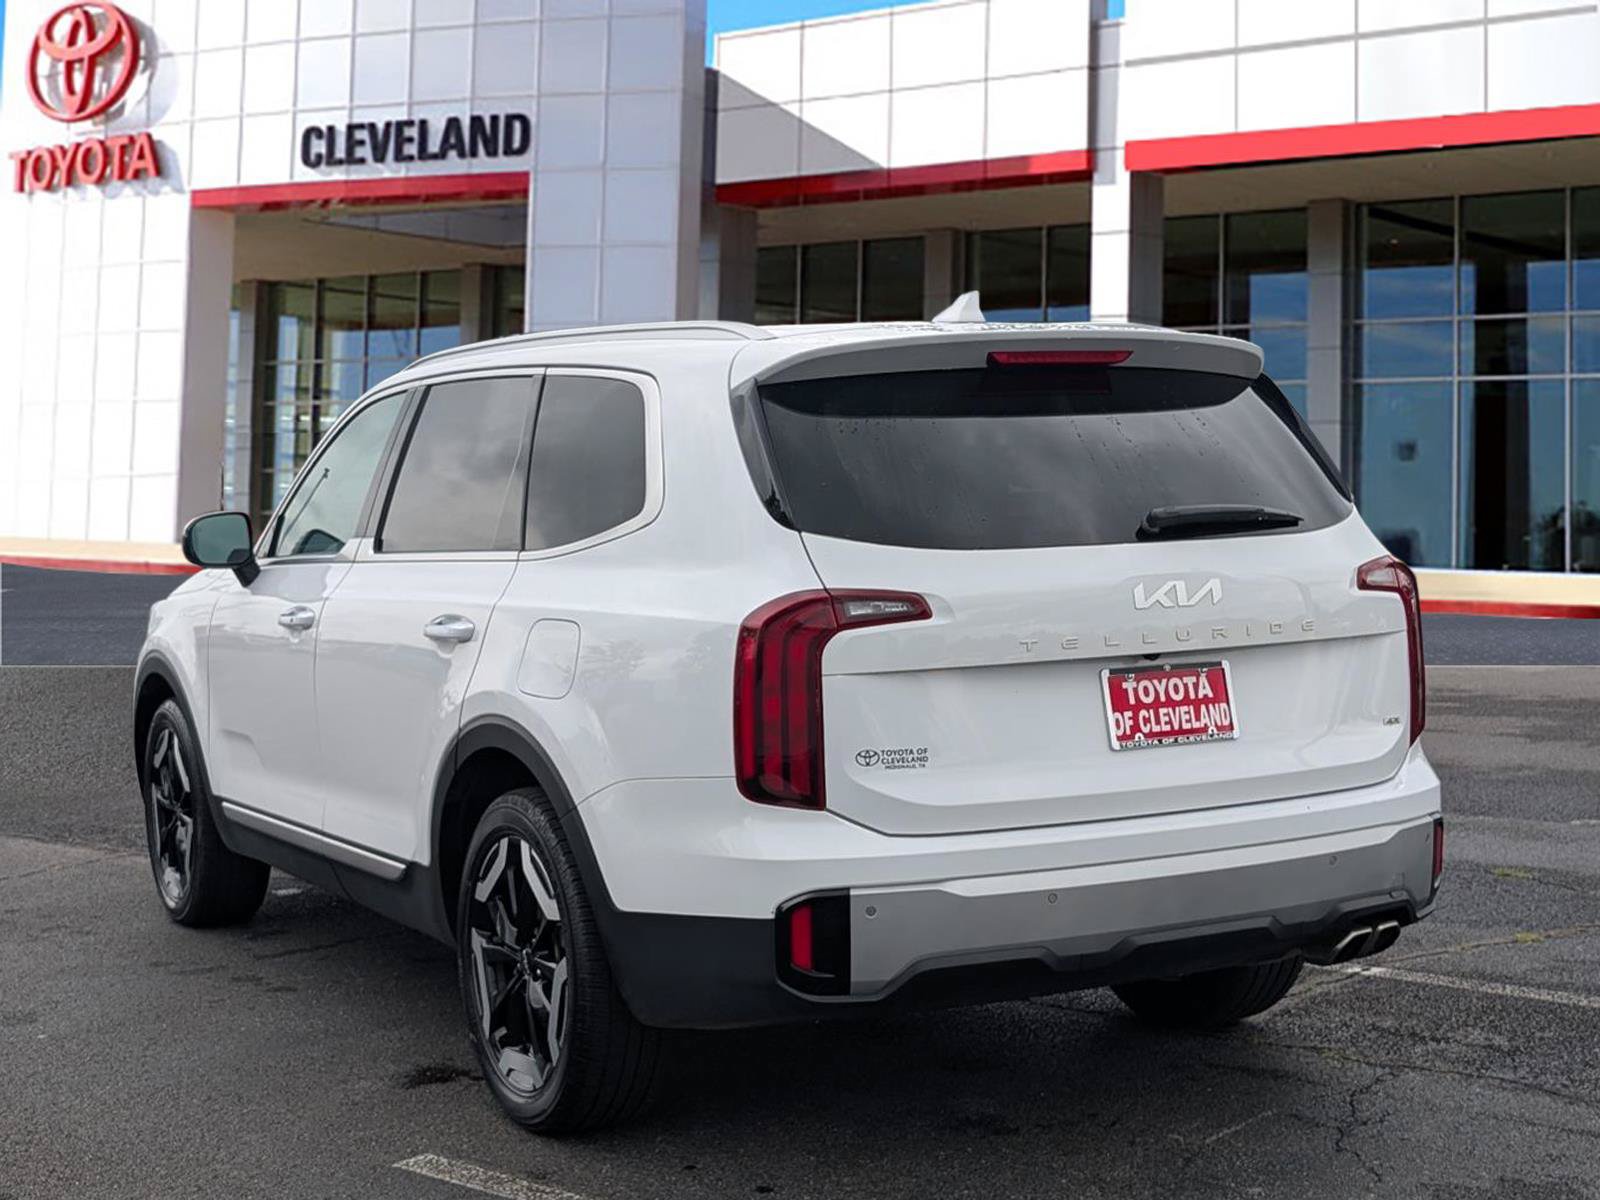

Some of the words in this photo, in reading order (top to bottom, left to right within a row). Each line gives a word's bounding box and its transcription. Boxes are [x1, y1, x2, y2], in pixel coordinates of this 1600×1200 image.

[301, 112, 532, 169] CLEVELAND
[9, 131, 161, 194] TOYOTA
[1020, 618, 1316, 653] TELLURIDE
[1121, 672, 1214, 706] TOYOTA
[1112, 710, 1134, 737] OF
[1138, 702, 1232, 734] CLEVELAND
[880, 748, 915, 757] TOYOTA
[916, 747, 928, 756] OF
[881, 755, 929, 765] CLEVELAND
[1121, 738, 1160, 749] TOYOTA
[1162, 737, 1175, 746] OF
